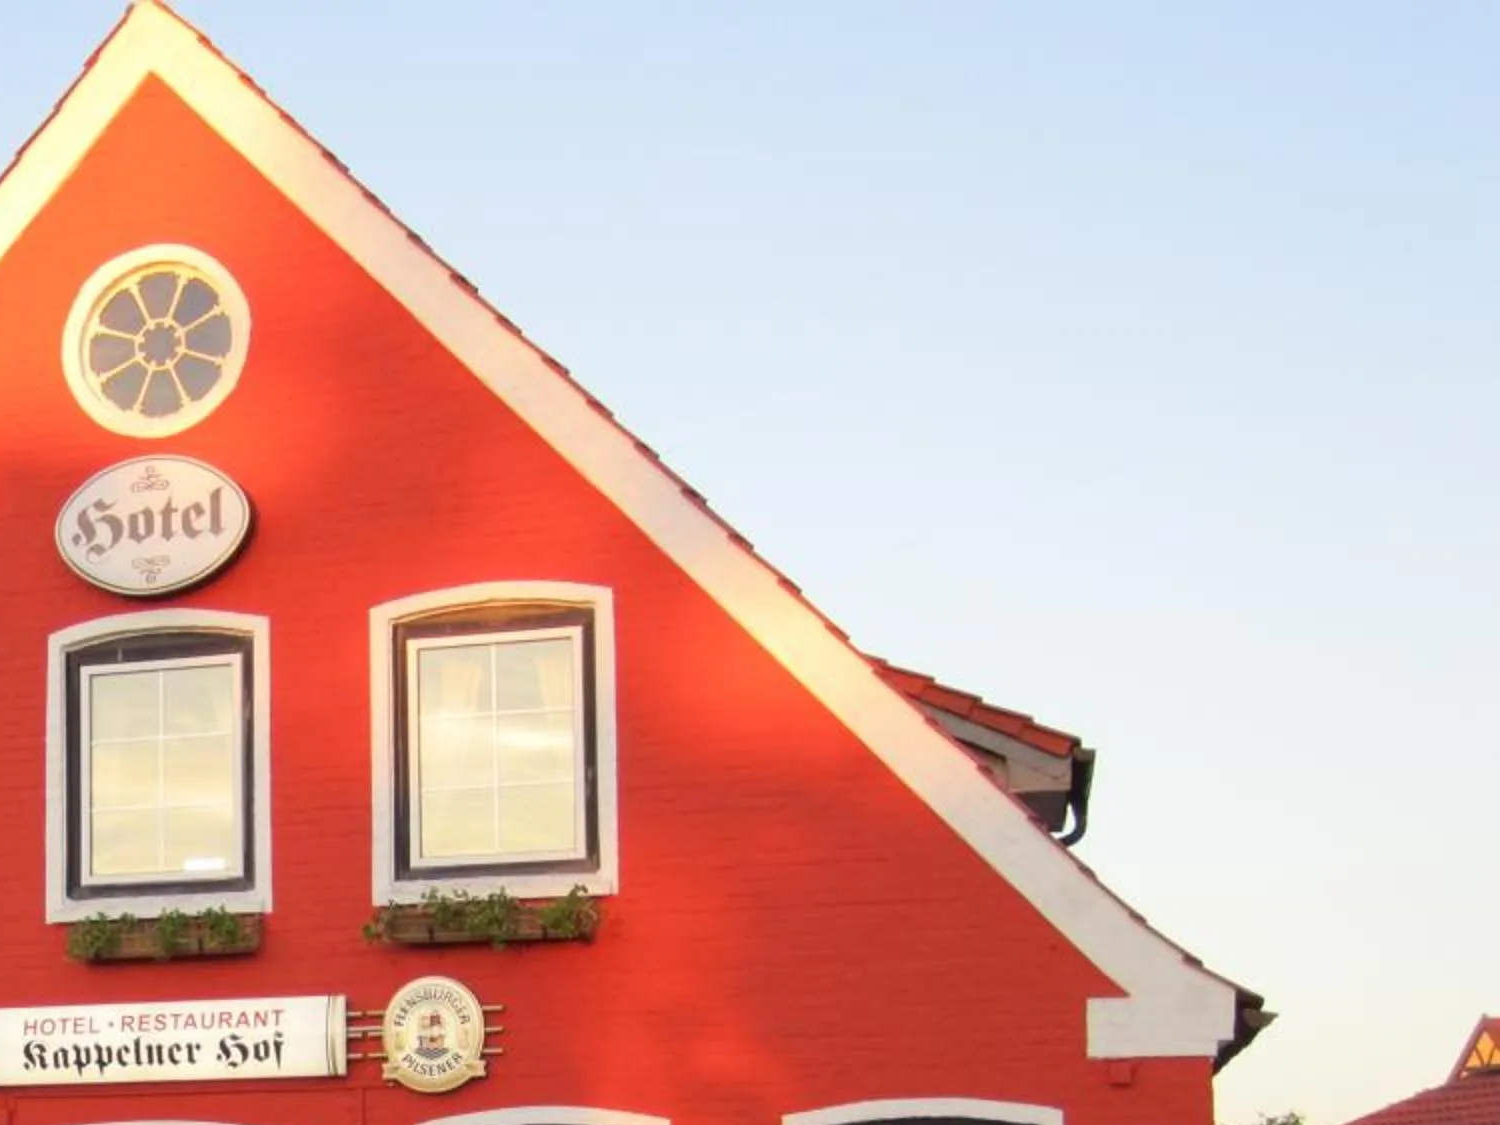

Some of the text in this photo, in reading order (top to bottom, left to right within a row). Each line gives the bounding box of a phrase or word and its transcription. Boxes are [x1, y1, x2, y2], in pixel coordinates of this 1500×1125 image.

[71, 486, 226, 565] Hotel
[23, 1009, 284, 1036] HOTEL RESTAURANT
[23, 1031, 285, 1077] Kappelner Hof
[401, 1051, 463, 1077] PILSENER
